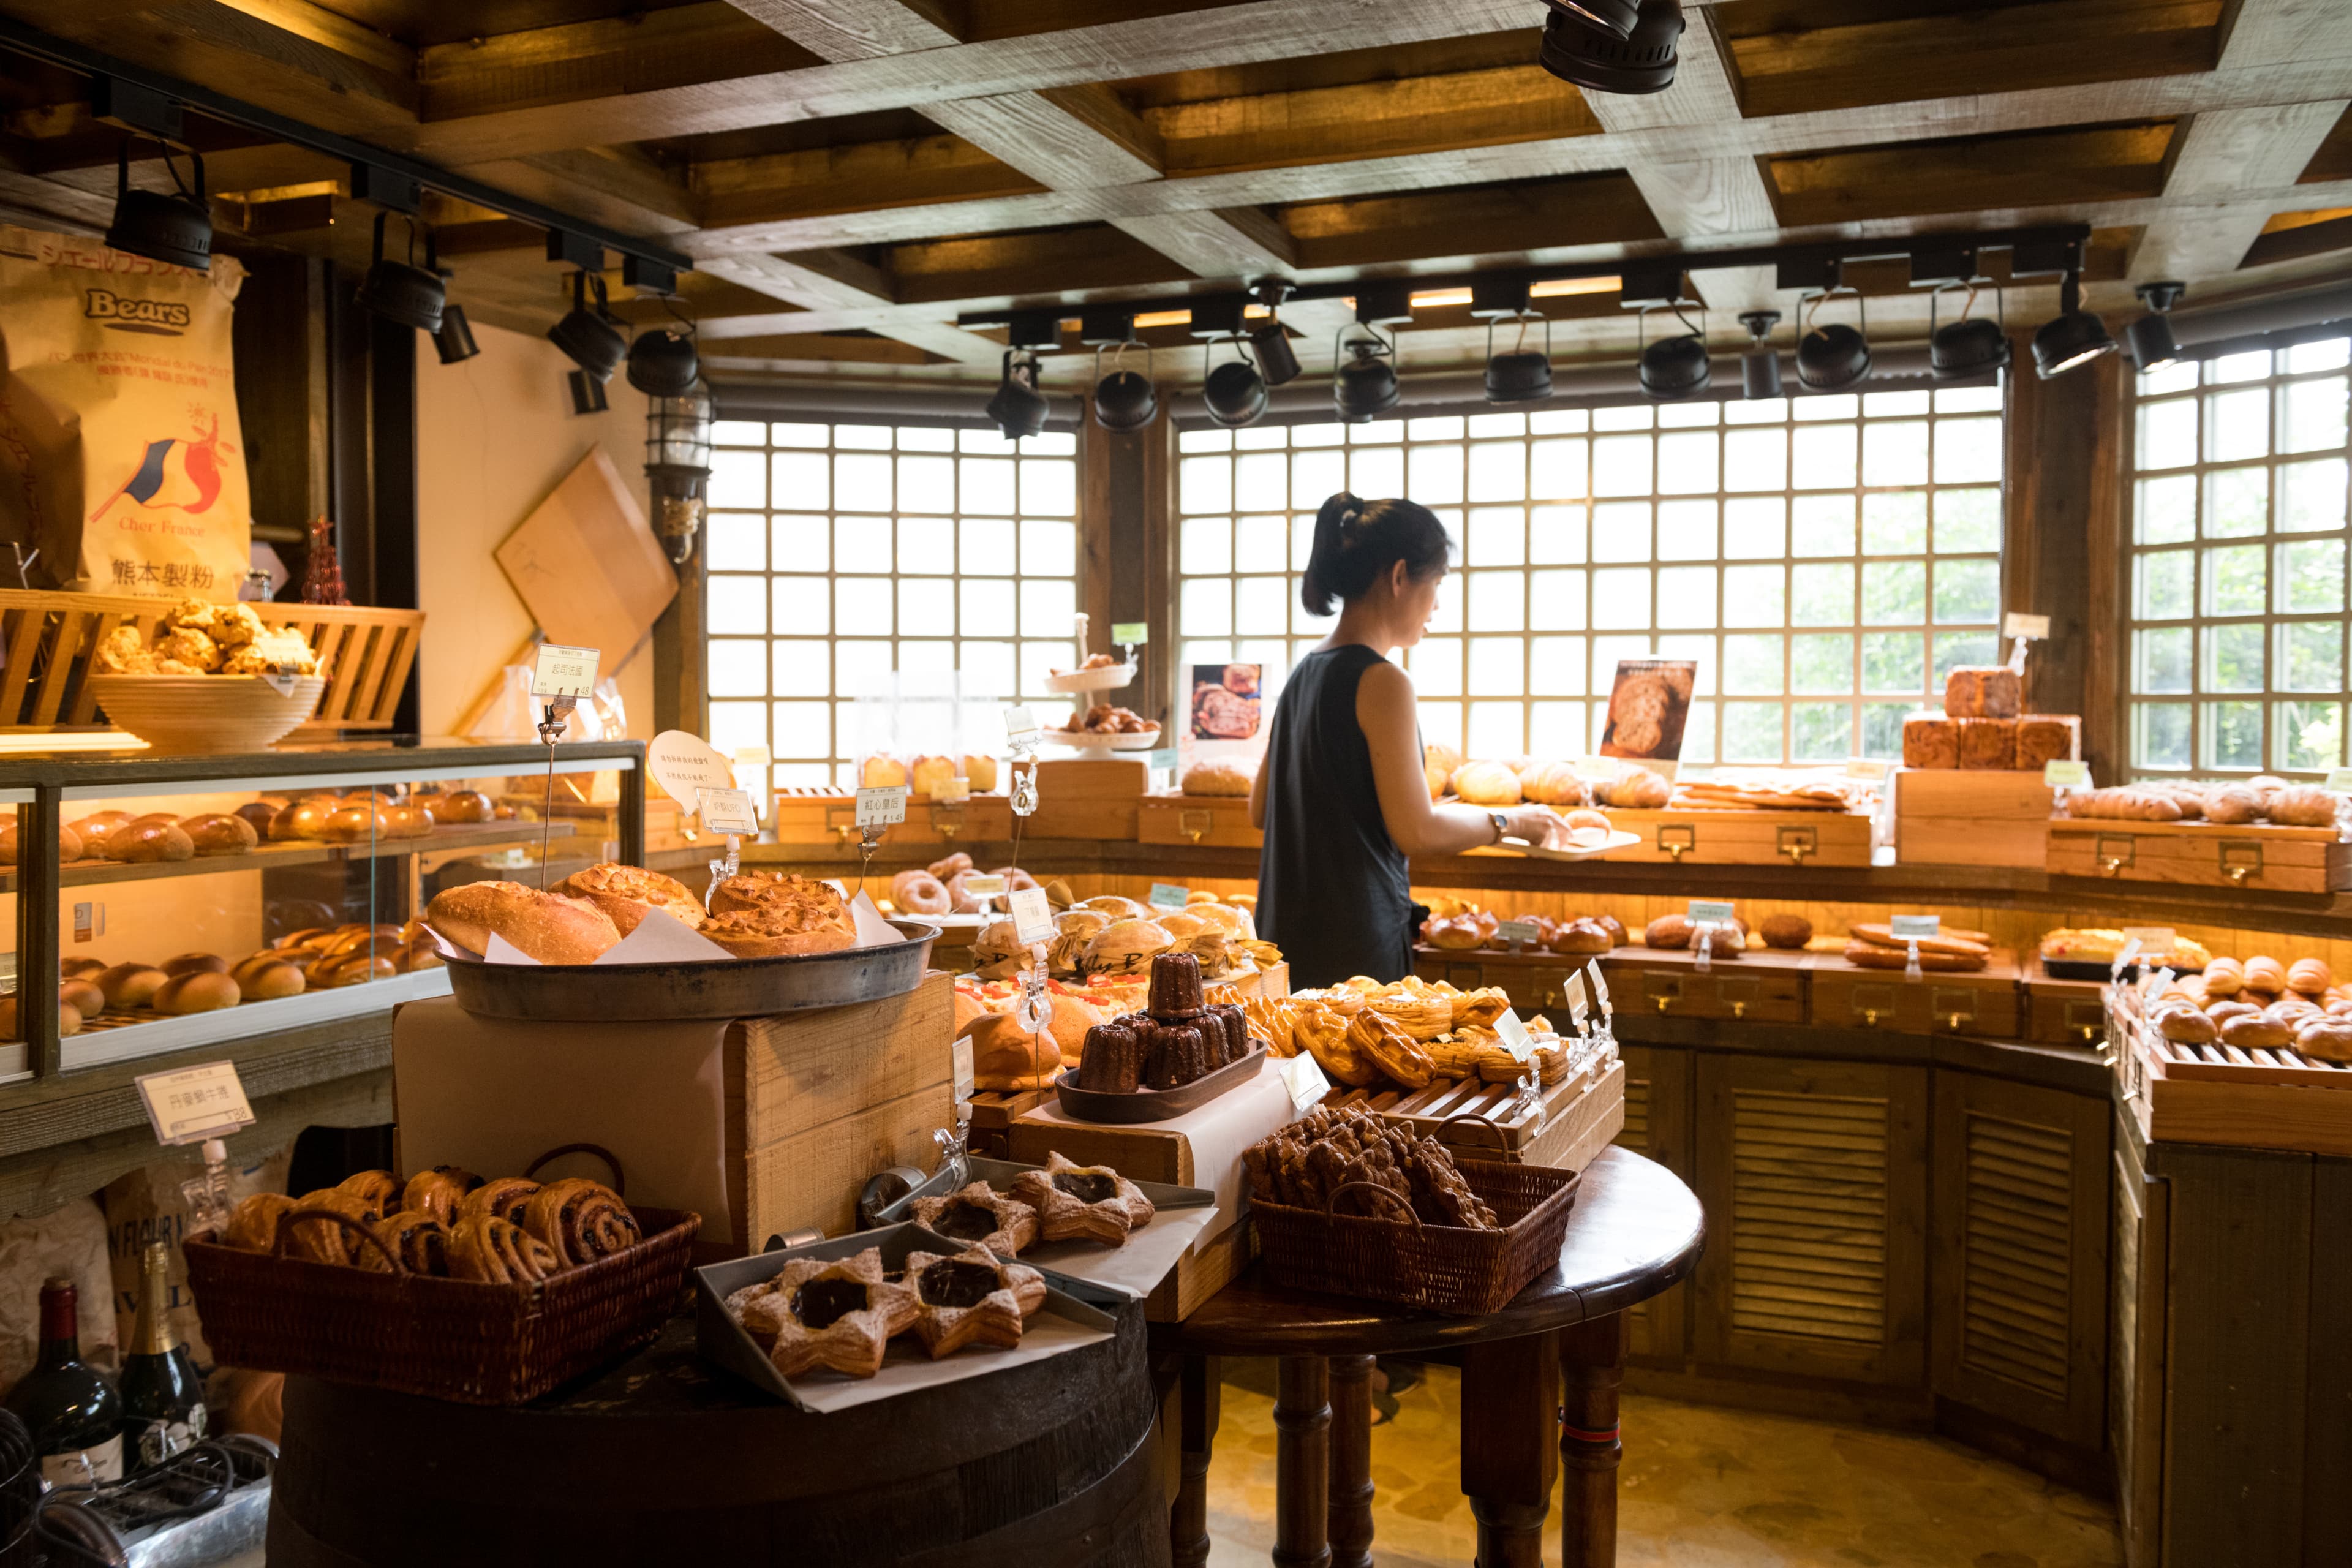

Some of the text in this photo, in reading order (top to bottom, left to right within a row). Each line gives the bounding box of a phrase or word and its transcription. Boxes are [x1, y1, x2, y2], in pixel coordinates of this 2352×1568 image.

[86, 289, 190, 326] Bears
[119, 516, 205, 537] Cher France
[111, 557, 214, 589] 熊本製粉
[865, 797, 899, 810] 紅心皇后
